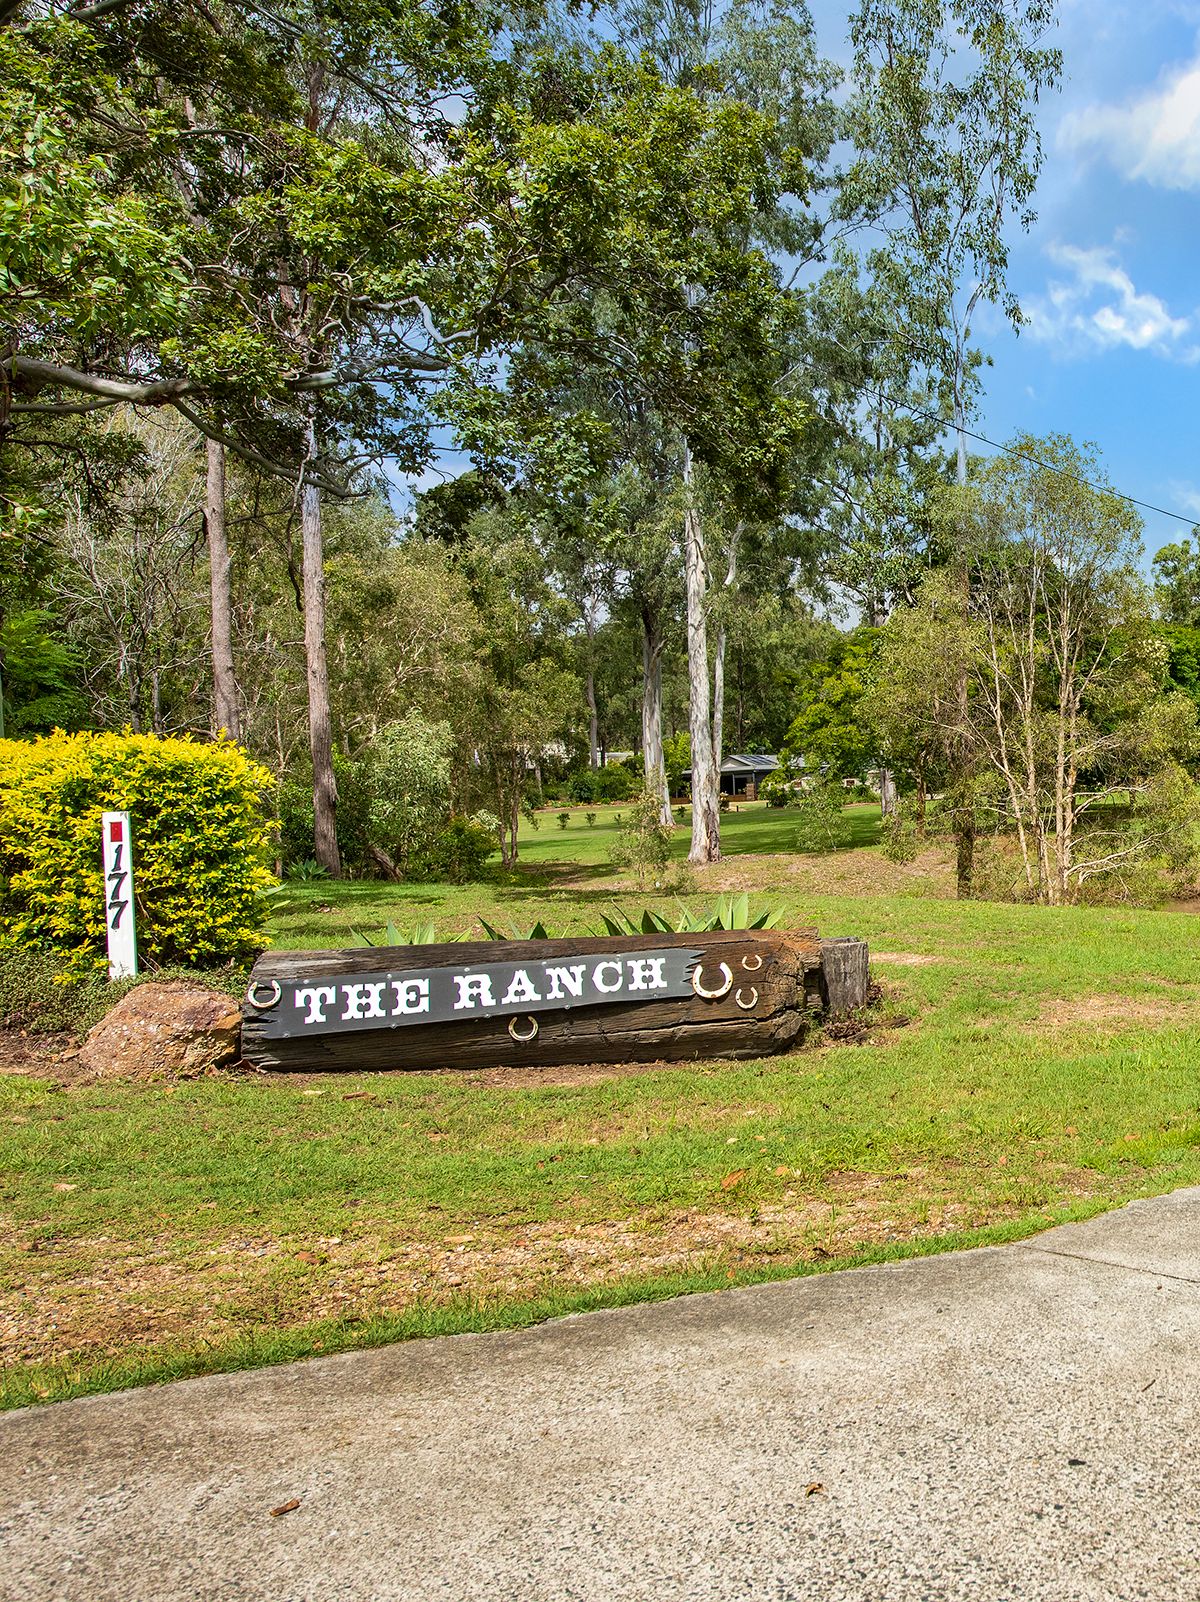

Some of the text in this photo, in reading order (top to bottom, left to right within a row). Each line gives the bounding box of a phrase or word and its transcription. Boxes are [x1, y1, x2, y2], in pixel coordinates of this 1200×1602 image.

[107, 844, 129, 930] 177
[294, 958, 668, 1024] THE RANCH
